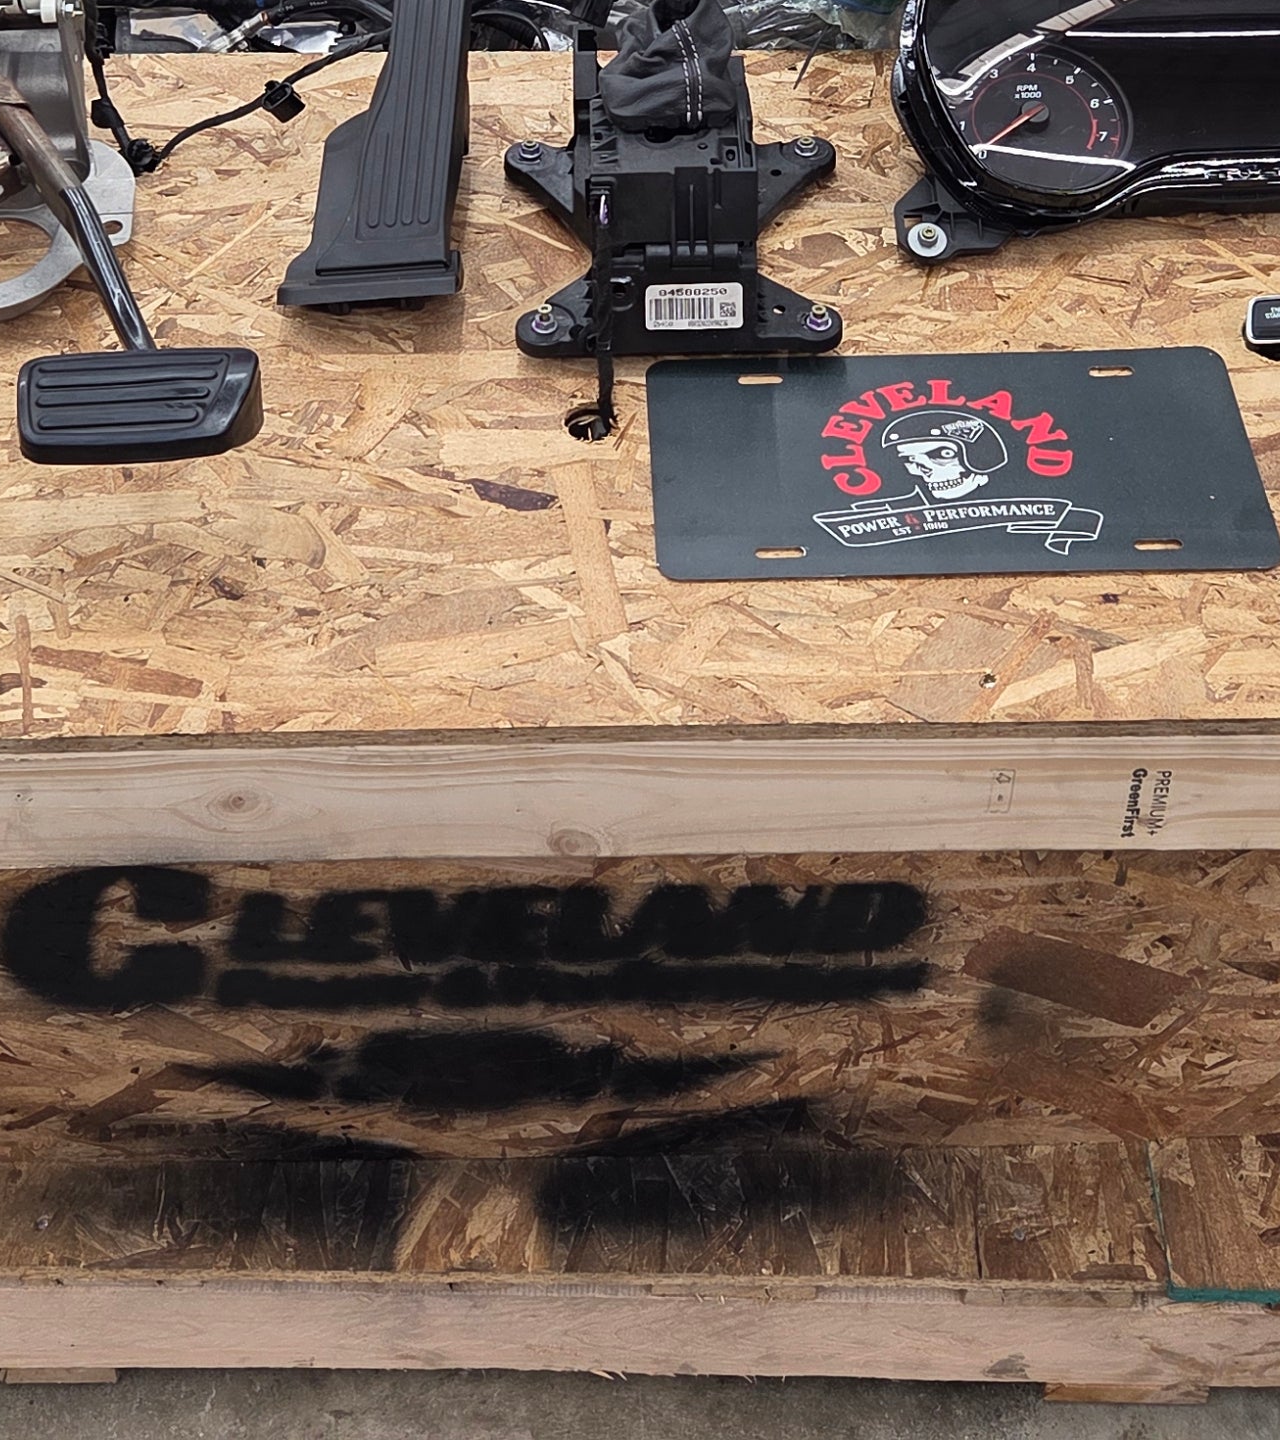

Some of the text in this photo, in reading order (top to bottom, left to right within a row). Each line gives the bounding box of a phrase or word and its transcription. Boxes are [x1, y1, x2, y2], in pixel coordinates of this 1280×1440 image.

[1026, 62, 1036, 73] 4
[989, 69, 999, 79] 3
[1065, 75, 1075, 85] 5
[1016, 84, 1038, 92] RPM
[964, 89, 974, 100] 2
[1089, 97, 1100, 108] 6
[1098, 131, 1108, 141] 7
[821, 379, 1073, 496] CLEVELAND
[836, 516, 902, 538] POWER
[922, 503, 1056, 522] PERFORMANCE
[1120, 768, 1148, 838] GreenFirst
[1147, 770, 1172, 836] PREMIUM+
[0, 864, 925, 1008] CLEVELAND
